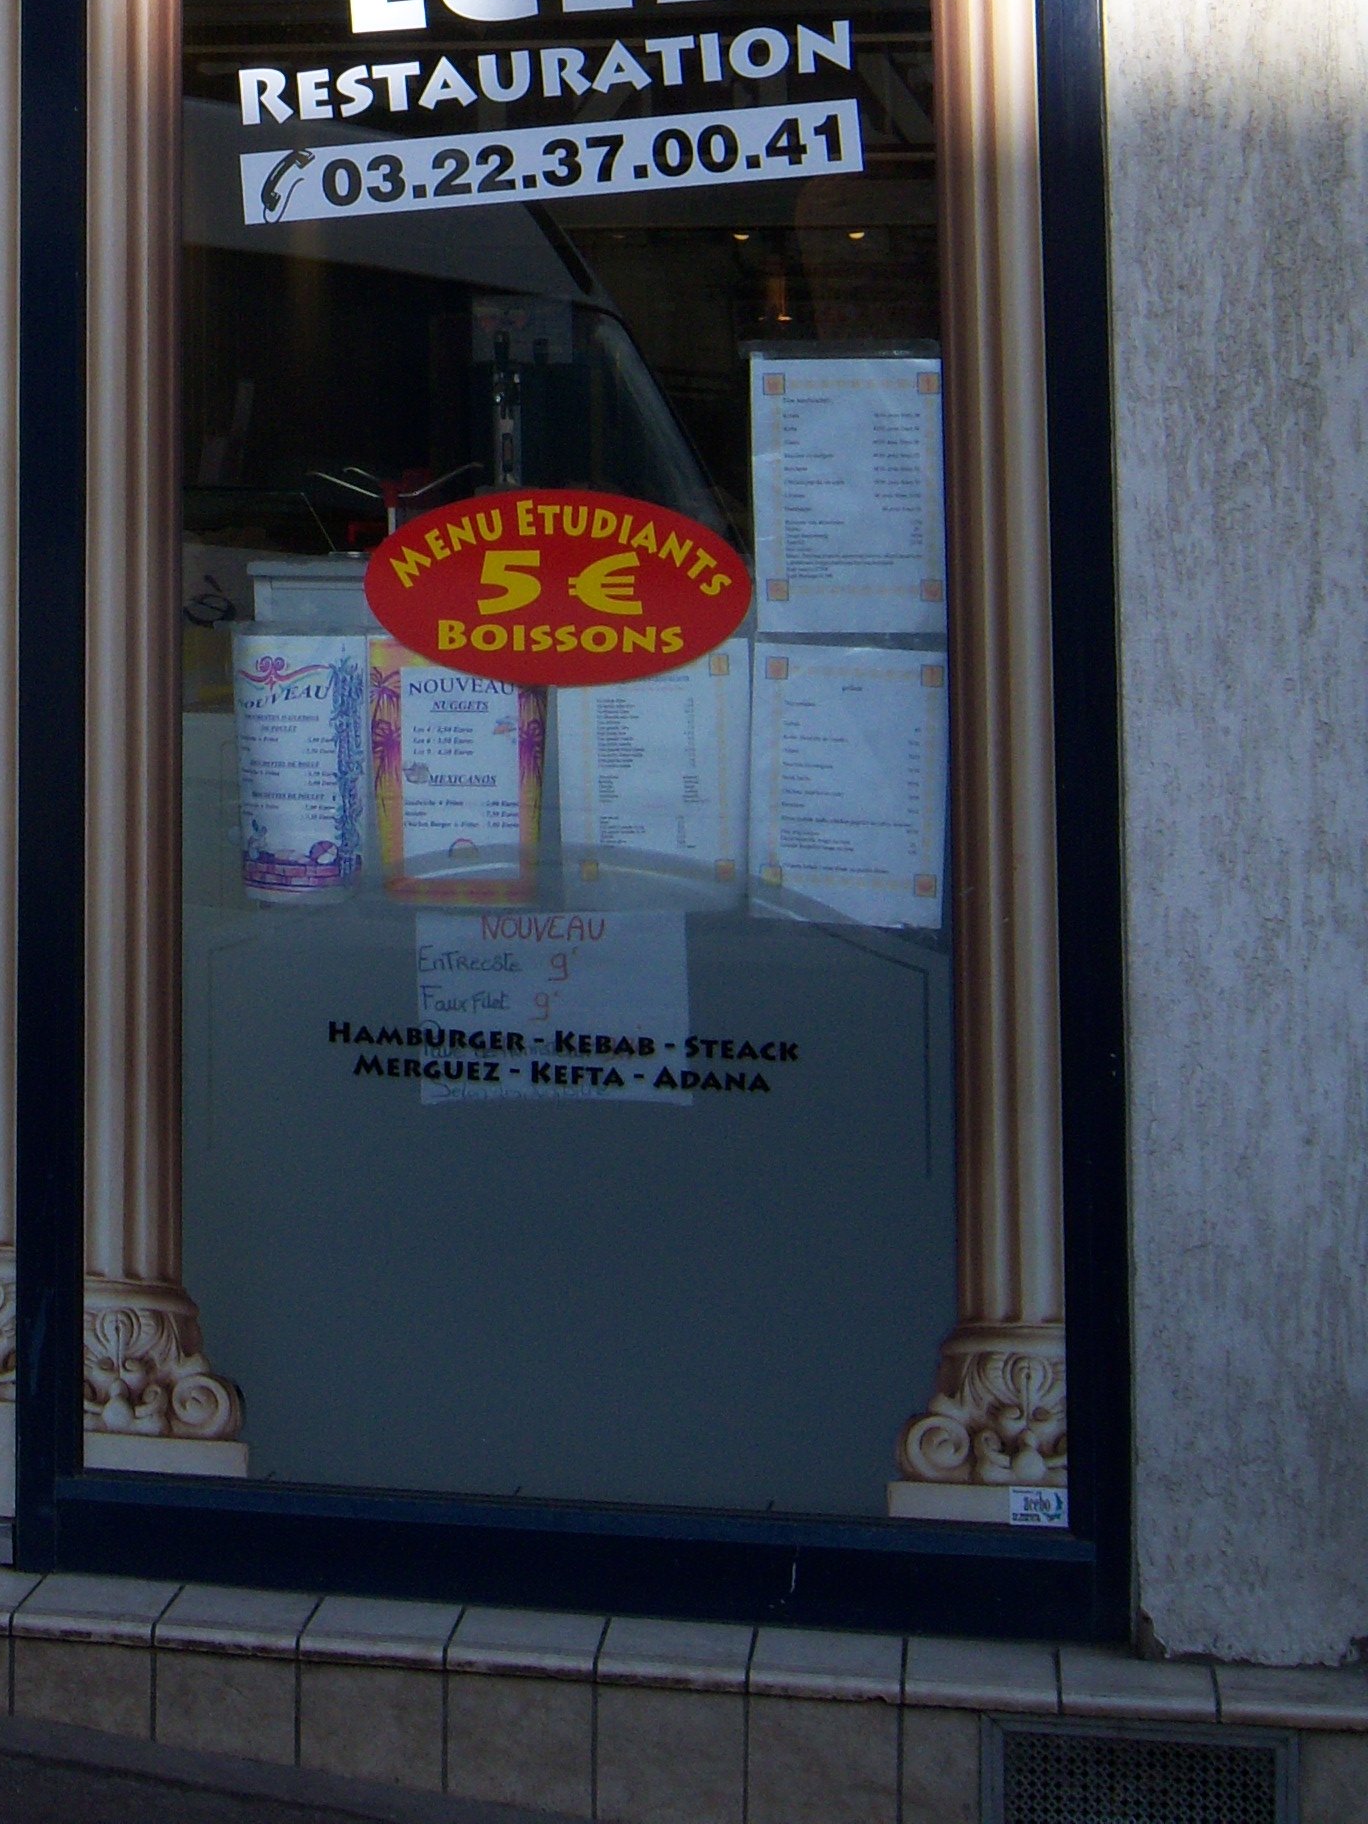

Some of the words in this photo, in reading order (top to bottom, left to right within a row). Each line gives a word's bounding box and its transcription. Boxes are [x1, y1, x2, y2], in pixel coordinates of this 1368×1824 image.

[239, 21, 851, 126] RESTAURATION
[323, 114, 842, 207] 03.22.37.00.41
[390, 509, 503, 588] MENU
[516, 499, 732, 597] ETUDIANTS
[477, 549, 542, 616] 5
[568, 551, 644, 616] €
[438, 619, 684, 653] BOISSONS
[409, 677, 515, 696] NOUVEAU
[432, 700, 490, 711] NUGGETS
[429, 774, 498, 785] MEXICANOS
[480, 914, 607, 943] NOUVEAU
[328, 1021, 525, 1052] HAMBURGER
[555, 1030, 655, 1057] KEBAB
[684, 1036, 799, 1062] STEACK
[353, 1054, 500, 1082] MERGUEZ
[531, 1061, 625, 1087] KEFTA
[653, 1066, 771, 1093] ADANA
